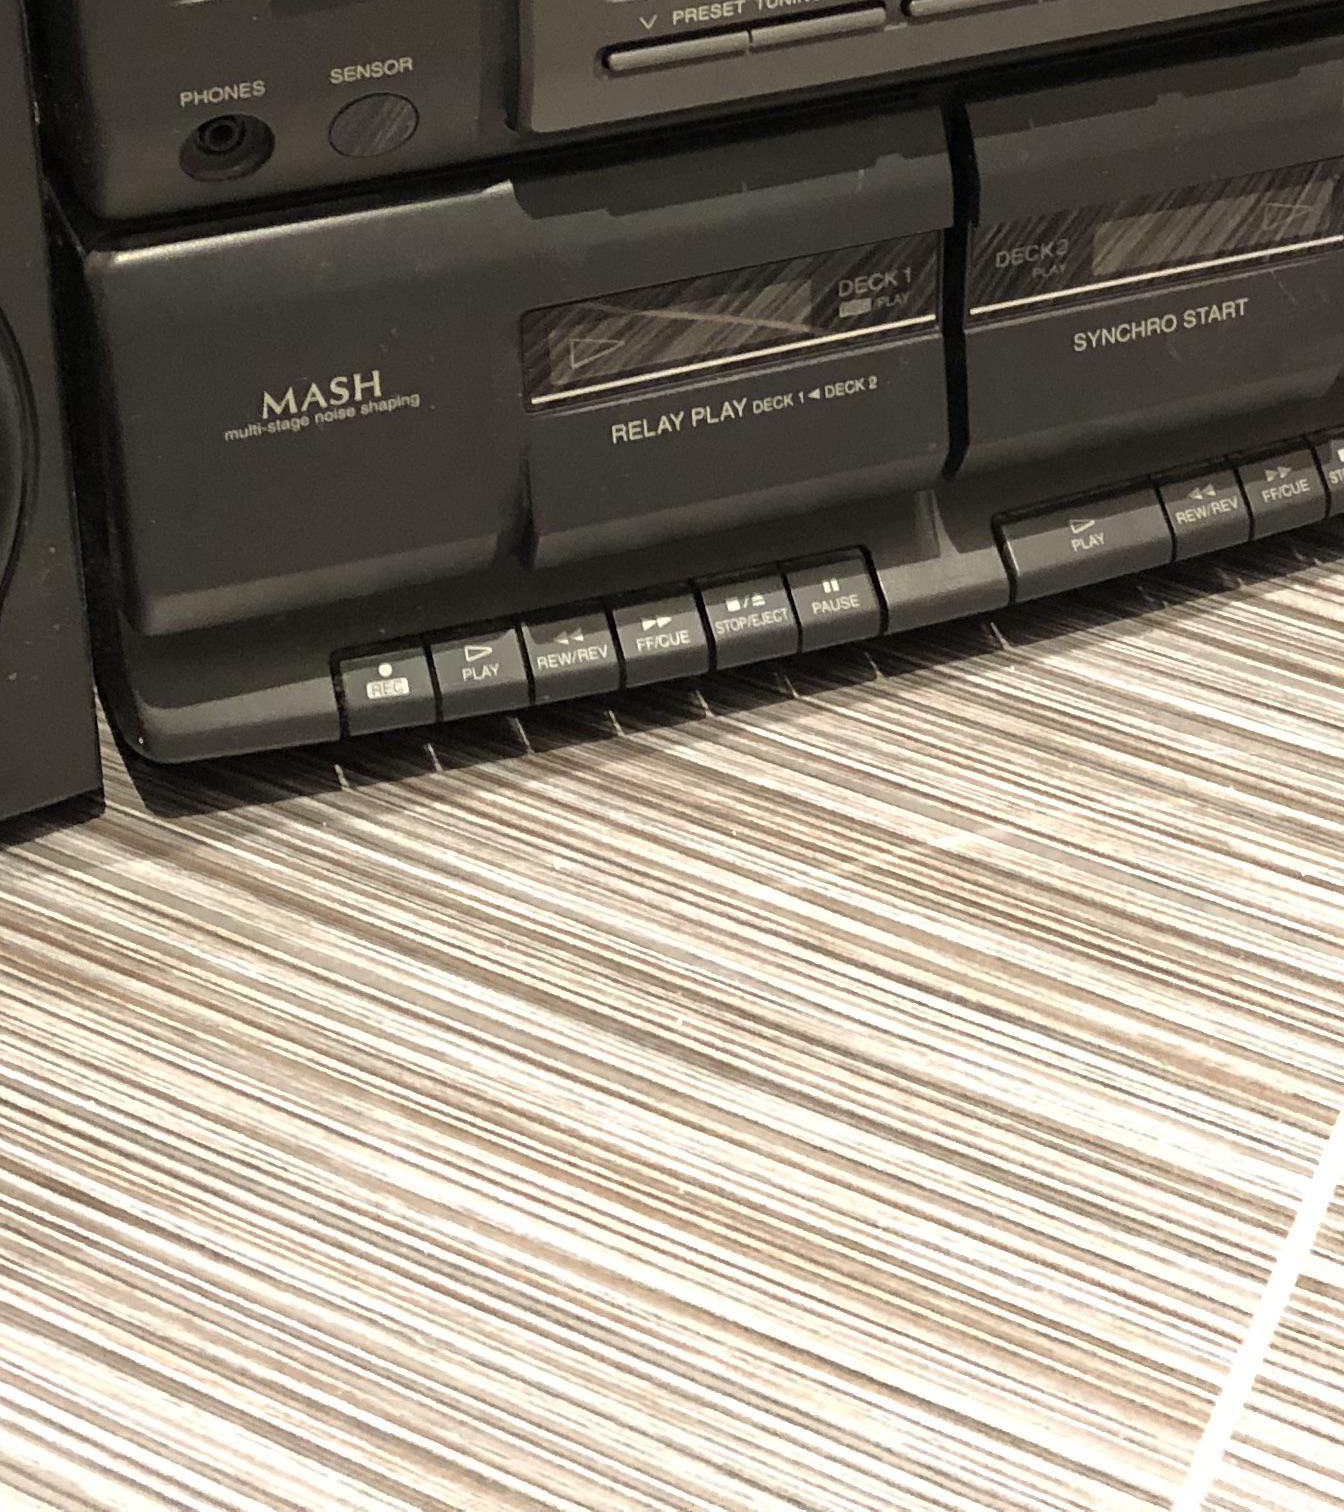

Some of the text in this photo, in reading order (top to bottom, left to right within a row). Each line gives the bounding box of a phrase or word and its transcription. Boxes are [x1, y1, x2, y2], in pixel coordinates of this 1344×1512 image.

[672, 0, 745, 25] PRESET
[330, 57, 413, 84] SENSOR
[180, 80, 266, 107] PHONES
[995, 241, 1054, 268] DECK
[838, 267, 911, 297] DECK 1
[1073, 298, 1249, 352] SYNCHRO START
[262, 369, 383, 420] MASH
[224, 392, 421, 442] multi-stage noise shaping
[611, 376, 877, 445] RELAY PLAY DECK 1 DECK 2
[1262, 479, 1311, 503] FF/CUE
[1175, 496, 1239, 525] REW/REV
[1071, 532, 1105, 552] PLAY
[812, 593, 861, 616] PAUSE
[715, 607, 789, 635] STOP/EJECT
[636, 629, 691, 653] FF/CUE
[537, 645, 609, 671] REW/REV
[462, 663, 499, 682] PLAY
[371, 680, 405, 698] REC
